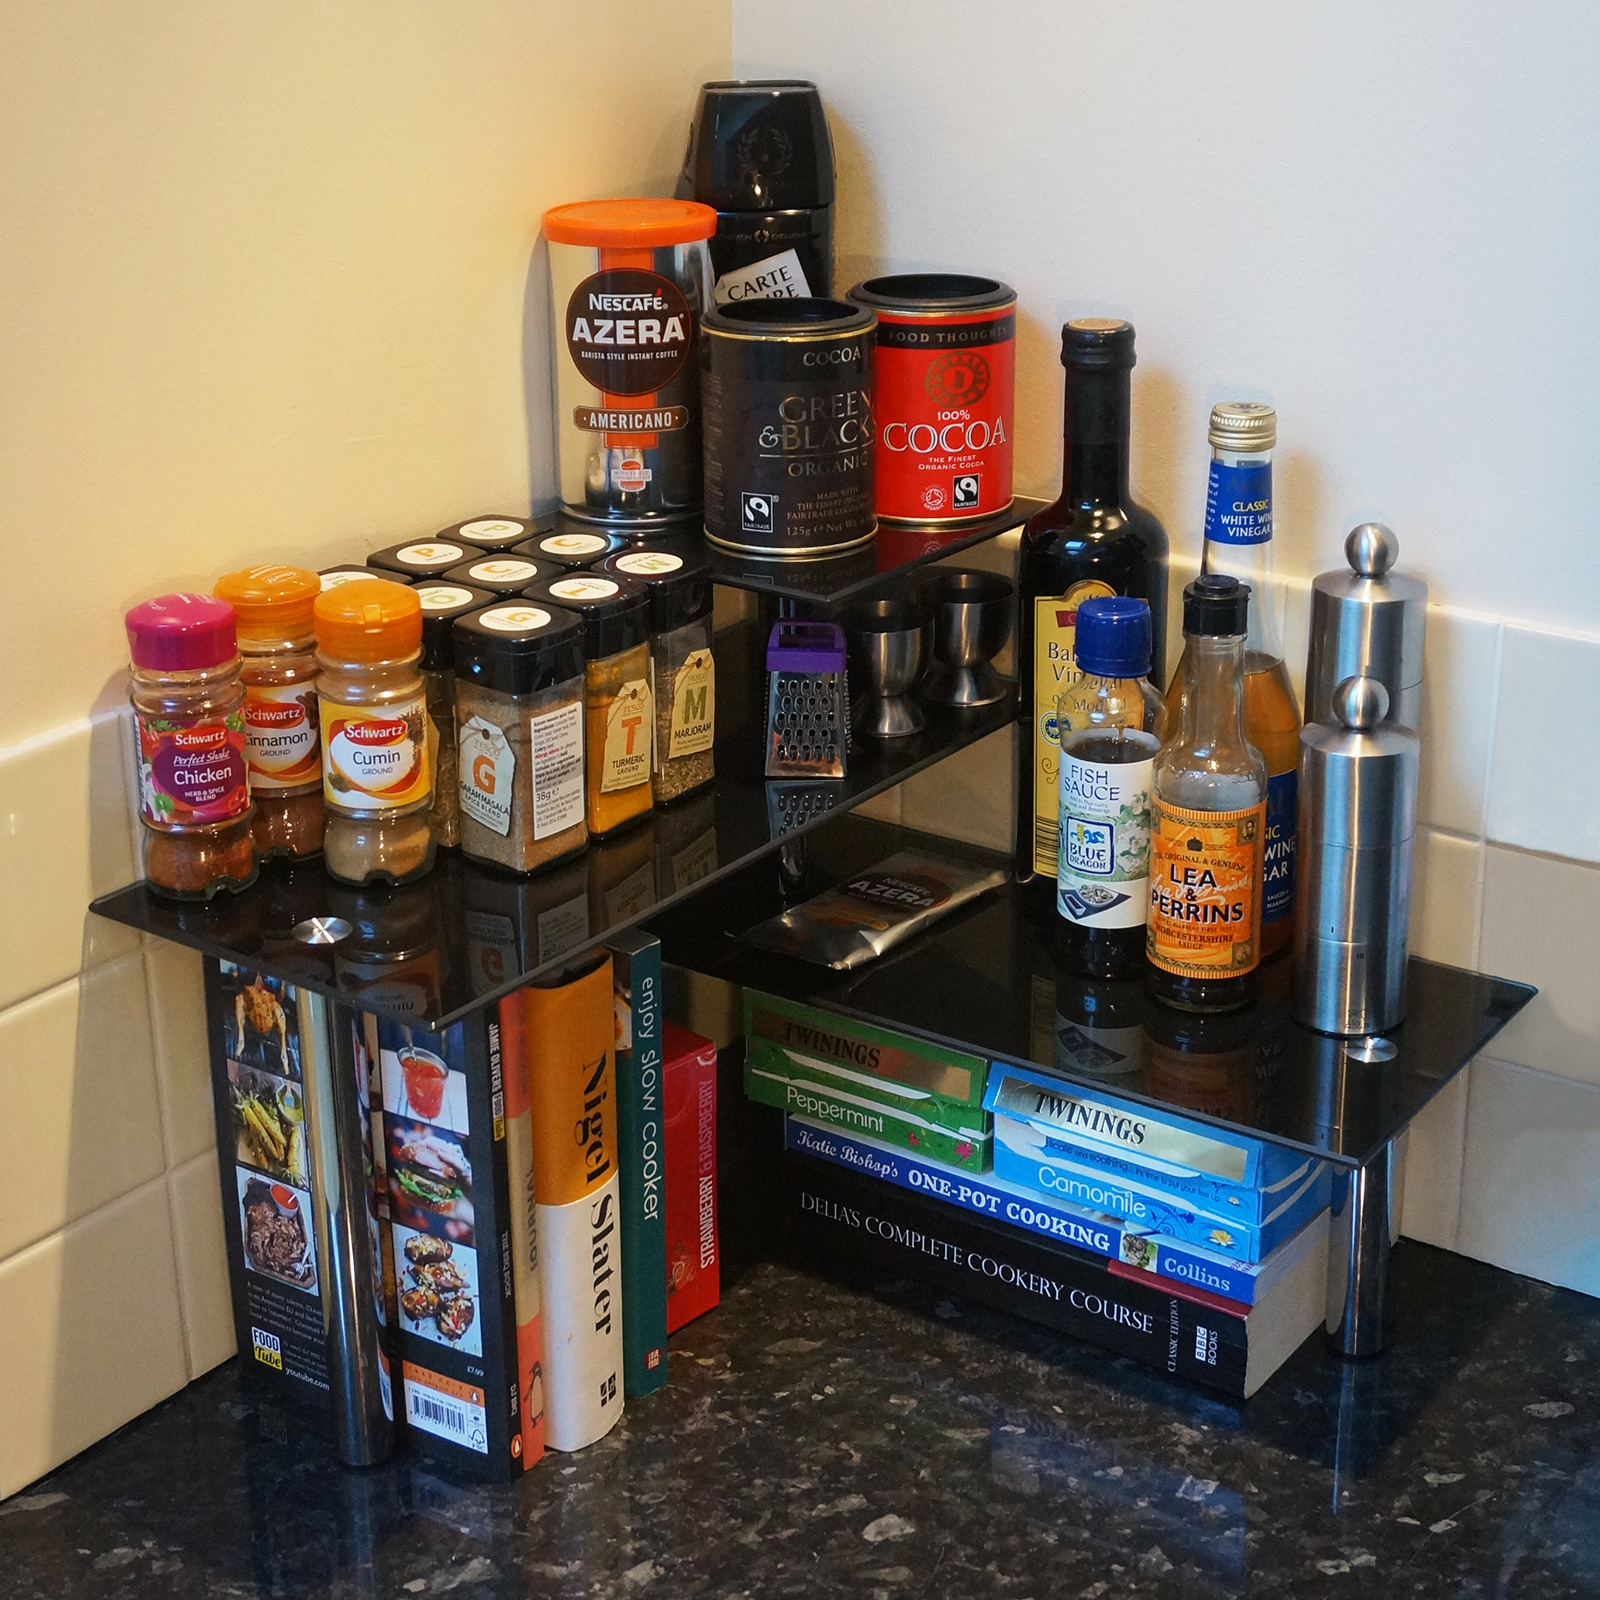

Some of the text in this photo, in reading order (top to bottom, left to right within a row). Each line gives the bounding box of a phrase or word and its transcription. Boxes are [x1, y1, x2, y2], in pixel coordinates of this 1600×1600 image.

[728, 266, 792, 301] CARTE
[572, 316, 685, 345] AZERA
[889, 331, 929, 342] FOOD
[581, 350, 678, 360] BARISTA STYLE INSTANT COFFEE
[803, 346, 860, 366] COCOA
[590, 412, 672, 429] AMERICANO
[937, 409, 970, 422] 100%
[883, 416, 1007, 454] COCOA
[788, 451, 869, 477] ORGANIC
[948, 454, 976, 463] FINEST
[960, 460, 985, 469] COCOA
[787, 508, 834, 520] FAIRTRADE
[797, 499, 841, 511] THE FINEST
[1232, 499, 1269, 512] CLASSIC
[744, 522, 771, 530] FAIRTRADE
[787, 526, 811, 537] 125g
[826, 523, 842, 533] Net
[1221, 514, 1255, 526] WHITE
[623, 702, 645, 713] TESCO
[684, 685, 707, 724] M
[245, 708, 301, 722] Schwartz
[175, 730, 225, 746] Schwartz
[346, 724, 404, 739] Schwartz
[621, 716, 642, 755] T
[674, 722, 712, 740] MARJORAM
[174, 748, 231, 768] Perfect Shake
[260, 749, 291, 757] GROUND
[353, 751, 401, 765] Cumin
[612, 754, 645, 769] TURMERIC
[174, 767, 232, 786] Chicken
[362, 767, 393, 775] GROUND
[473, 754, 496, 795] G
[617, 765, 639, 775] GROUND
[1071, 764, 1109, 785] FISH
[185, 790, 202, 798] HERB
[208, 786, 225, 796] SPICE
[195, 794, 217, 802] BLEND
[536, 791, 551, 803] 38g
[1064, 777, 1120, 801] SAUCE
[481, 794, 510, 815] MASALA
[481, 804, 501, 819] BLEND
[1070, 842, 1106, 862] BLUE
[1070, 855, 1106, 869] DRAGON
[1165, 852, 1201, 864] ORIGINAL
[1170, 863, 1217, 888] LEA
[848, 880, 935, 907] AZERA
[1185, 888, 1197, 902] &
[1151, 888, 1244, 924] PERRINS
[1156, 923, 1234, 944] WORCESTERSHIRE
[1178, 941, 1204, 950] SAUCE
[489, 1023, 501, 1054] JAMIE
[783, 1020, 881, 1069] TWININGS
[492, 1093, 504, 1118] FOOD
[638, 976, 662, 1221] enjoy slow cooker
[787, 1085, 883, 1133] Peppermint
[1034, 1092, 1146, 1145] TWININGS
[698, 1079, 715, 1270] STRAWBERRY & RASPBERRY
[575, 1049, 614, 1336] Nigel Slater
[796, 1131, 1111, 1252] Katie Bishop's ONE-POT COOKING
[1038, 1166, 1146, 1219] Camomile
[501, 1230, 512, 1299] THE BBQ BOOK
[801, 1192, 1154, 1334] DELIA'S COMPLETE COOKERY COURSE
[1164, 1257, 1231, 1292] Collins
[253, 1328, 279, 1351] FOOD
[1167, 1299, 1179, 1372] CLASSIC EDITION
[1195, 1325, 1208, 1362] BBC
[255, 1345, 281, 1367] Tube
[1207, 1329, 1218, 1366] BOOKS
[285, 1367, 330, 1391] youtube.com
